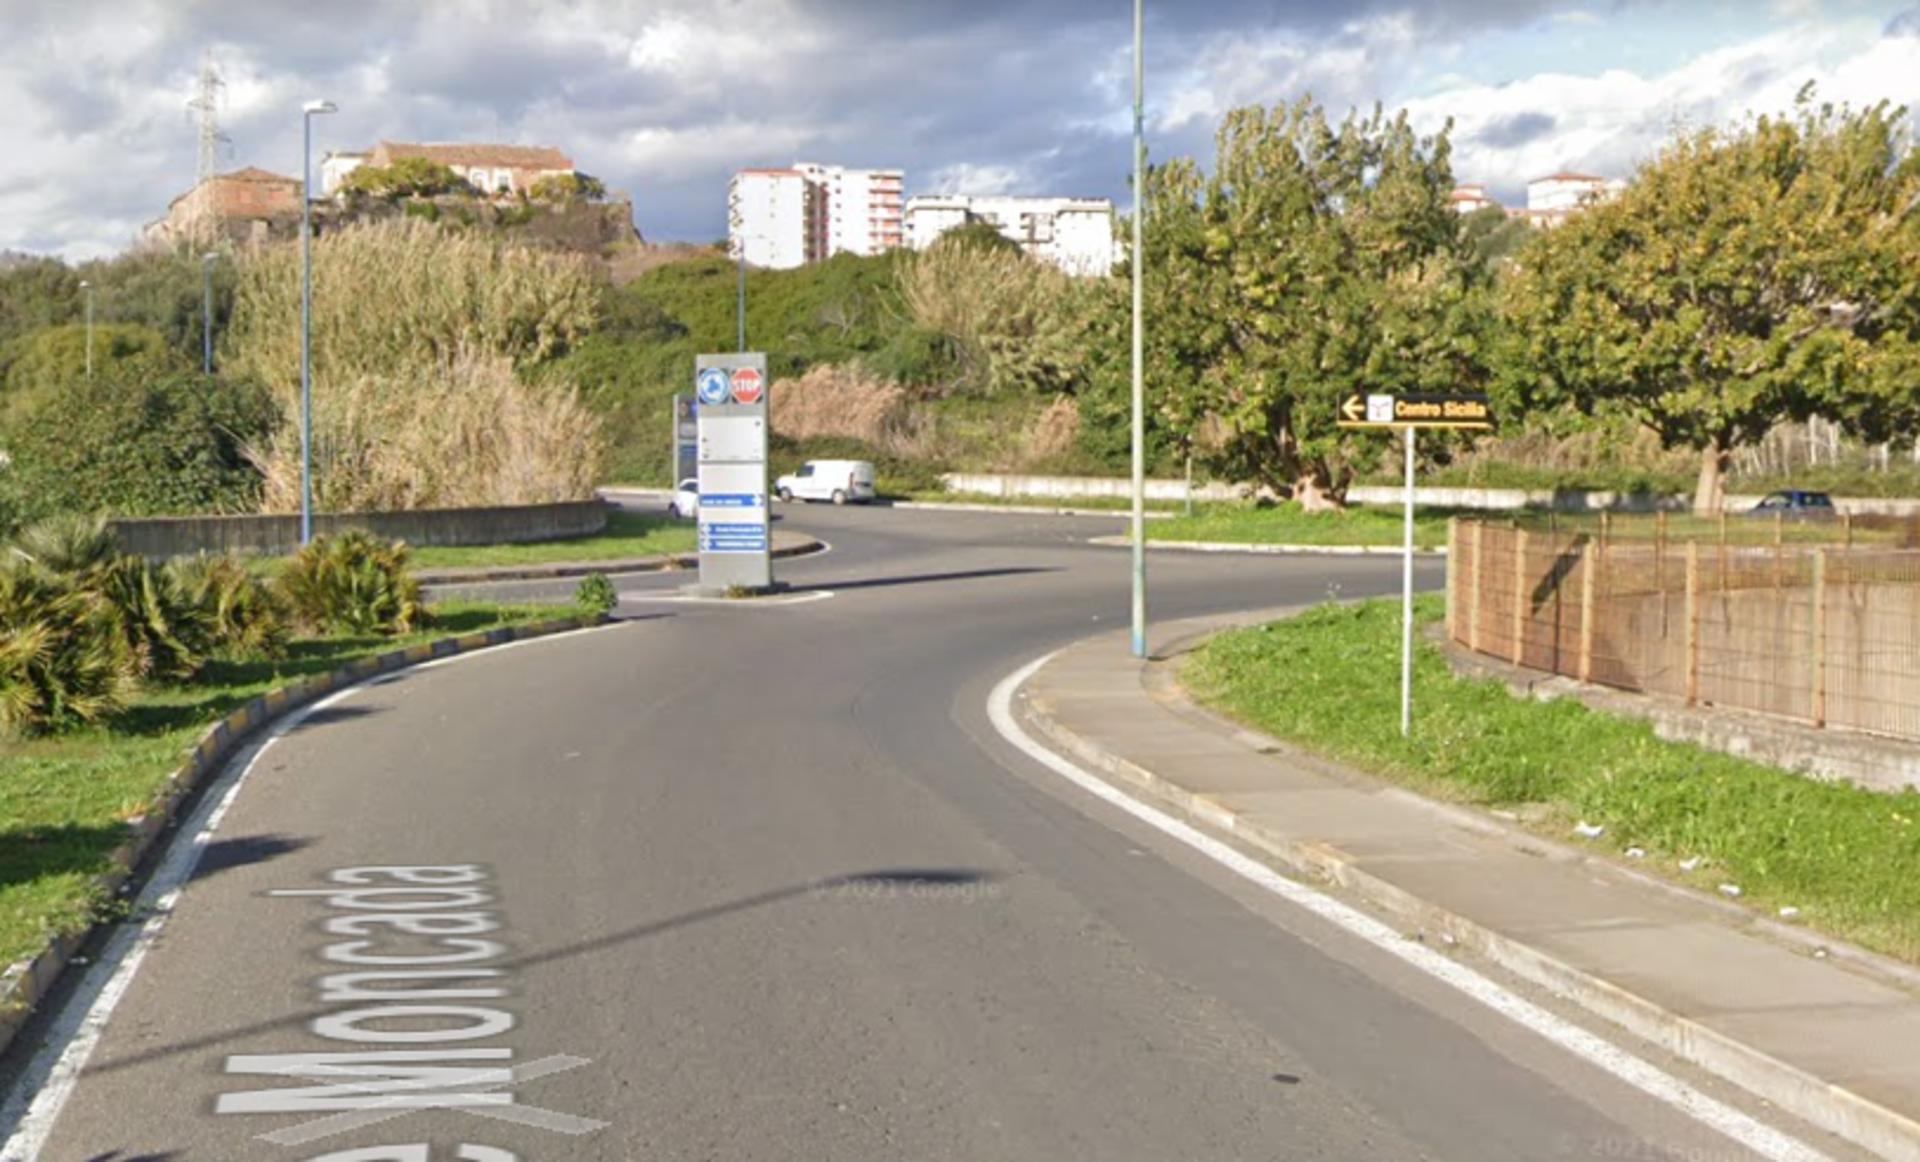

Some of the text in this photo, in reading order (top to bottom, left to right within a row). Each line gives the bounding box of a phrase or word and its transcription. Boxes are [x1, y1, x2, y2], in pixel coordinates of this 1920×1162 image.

[733, 378, 761, 392] STOP
[1395, 401, 1486, 417] Centro Sicilia
